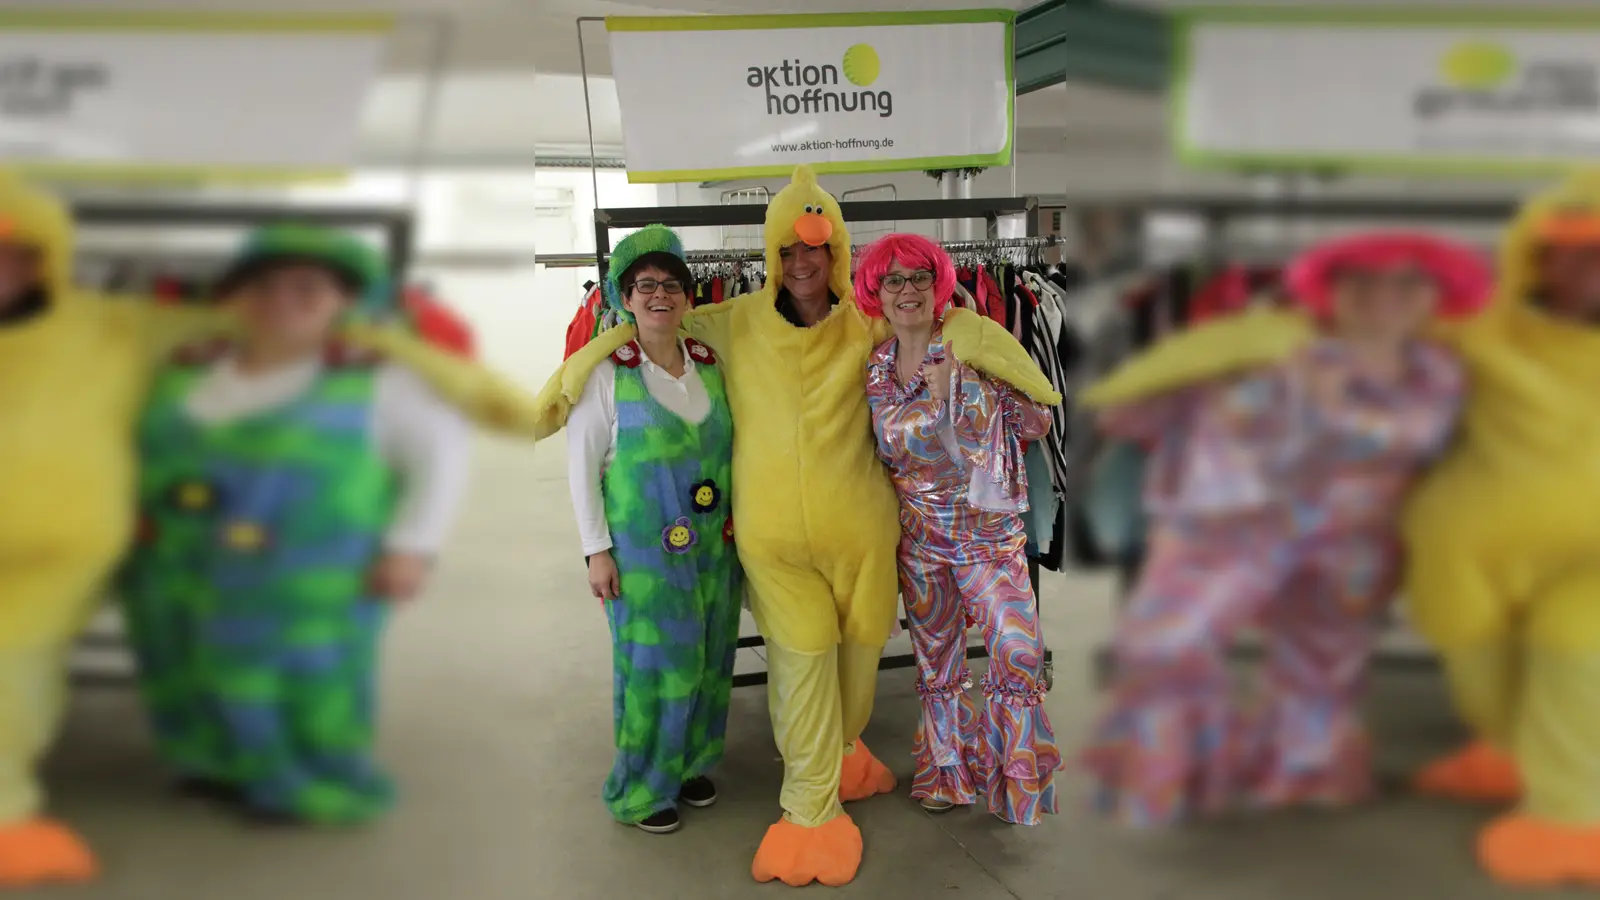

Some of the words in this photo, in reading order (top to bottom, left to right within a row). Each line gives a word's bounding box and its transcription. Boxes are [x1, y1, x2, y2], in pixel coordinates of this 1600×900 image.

[746, 59, 838, 87] aktion
[766, 87, 893, 118] hoffnung
[771, 137, 894, 152] www.aktion-hoffnung.de
